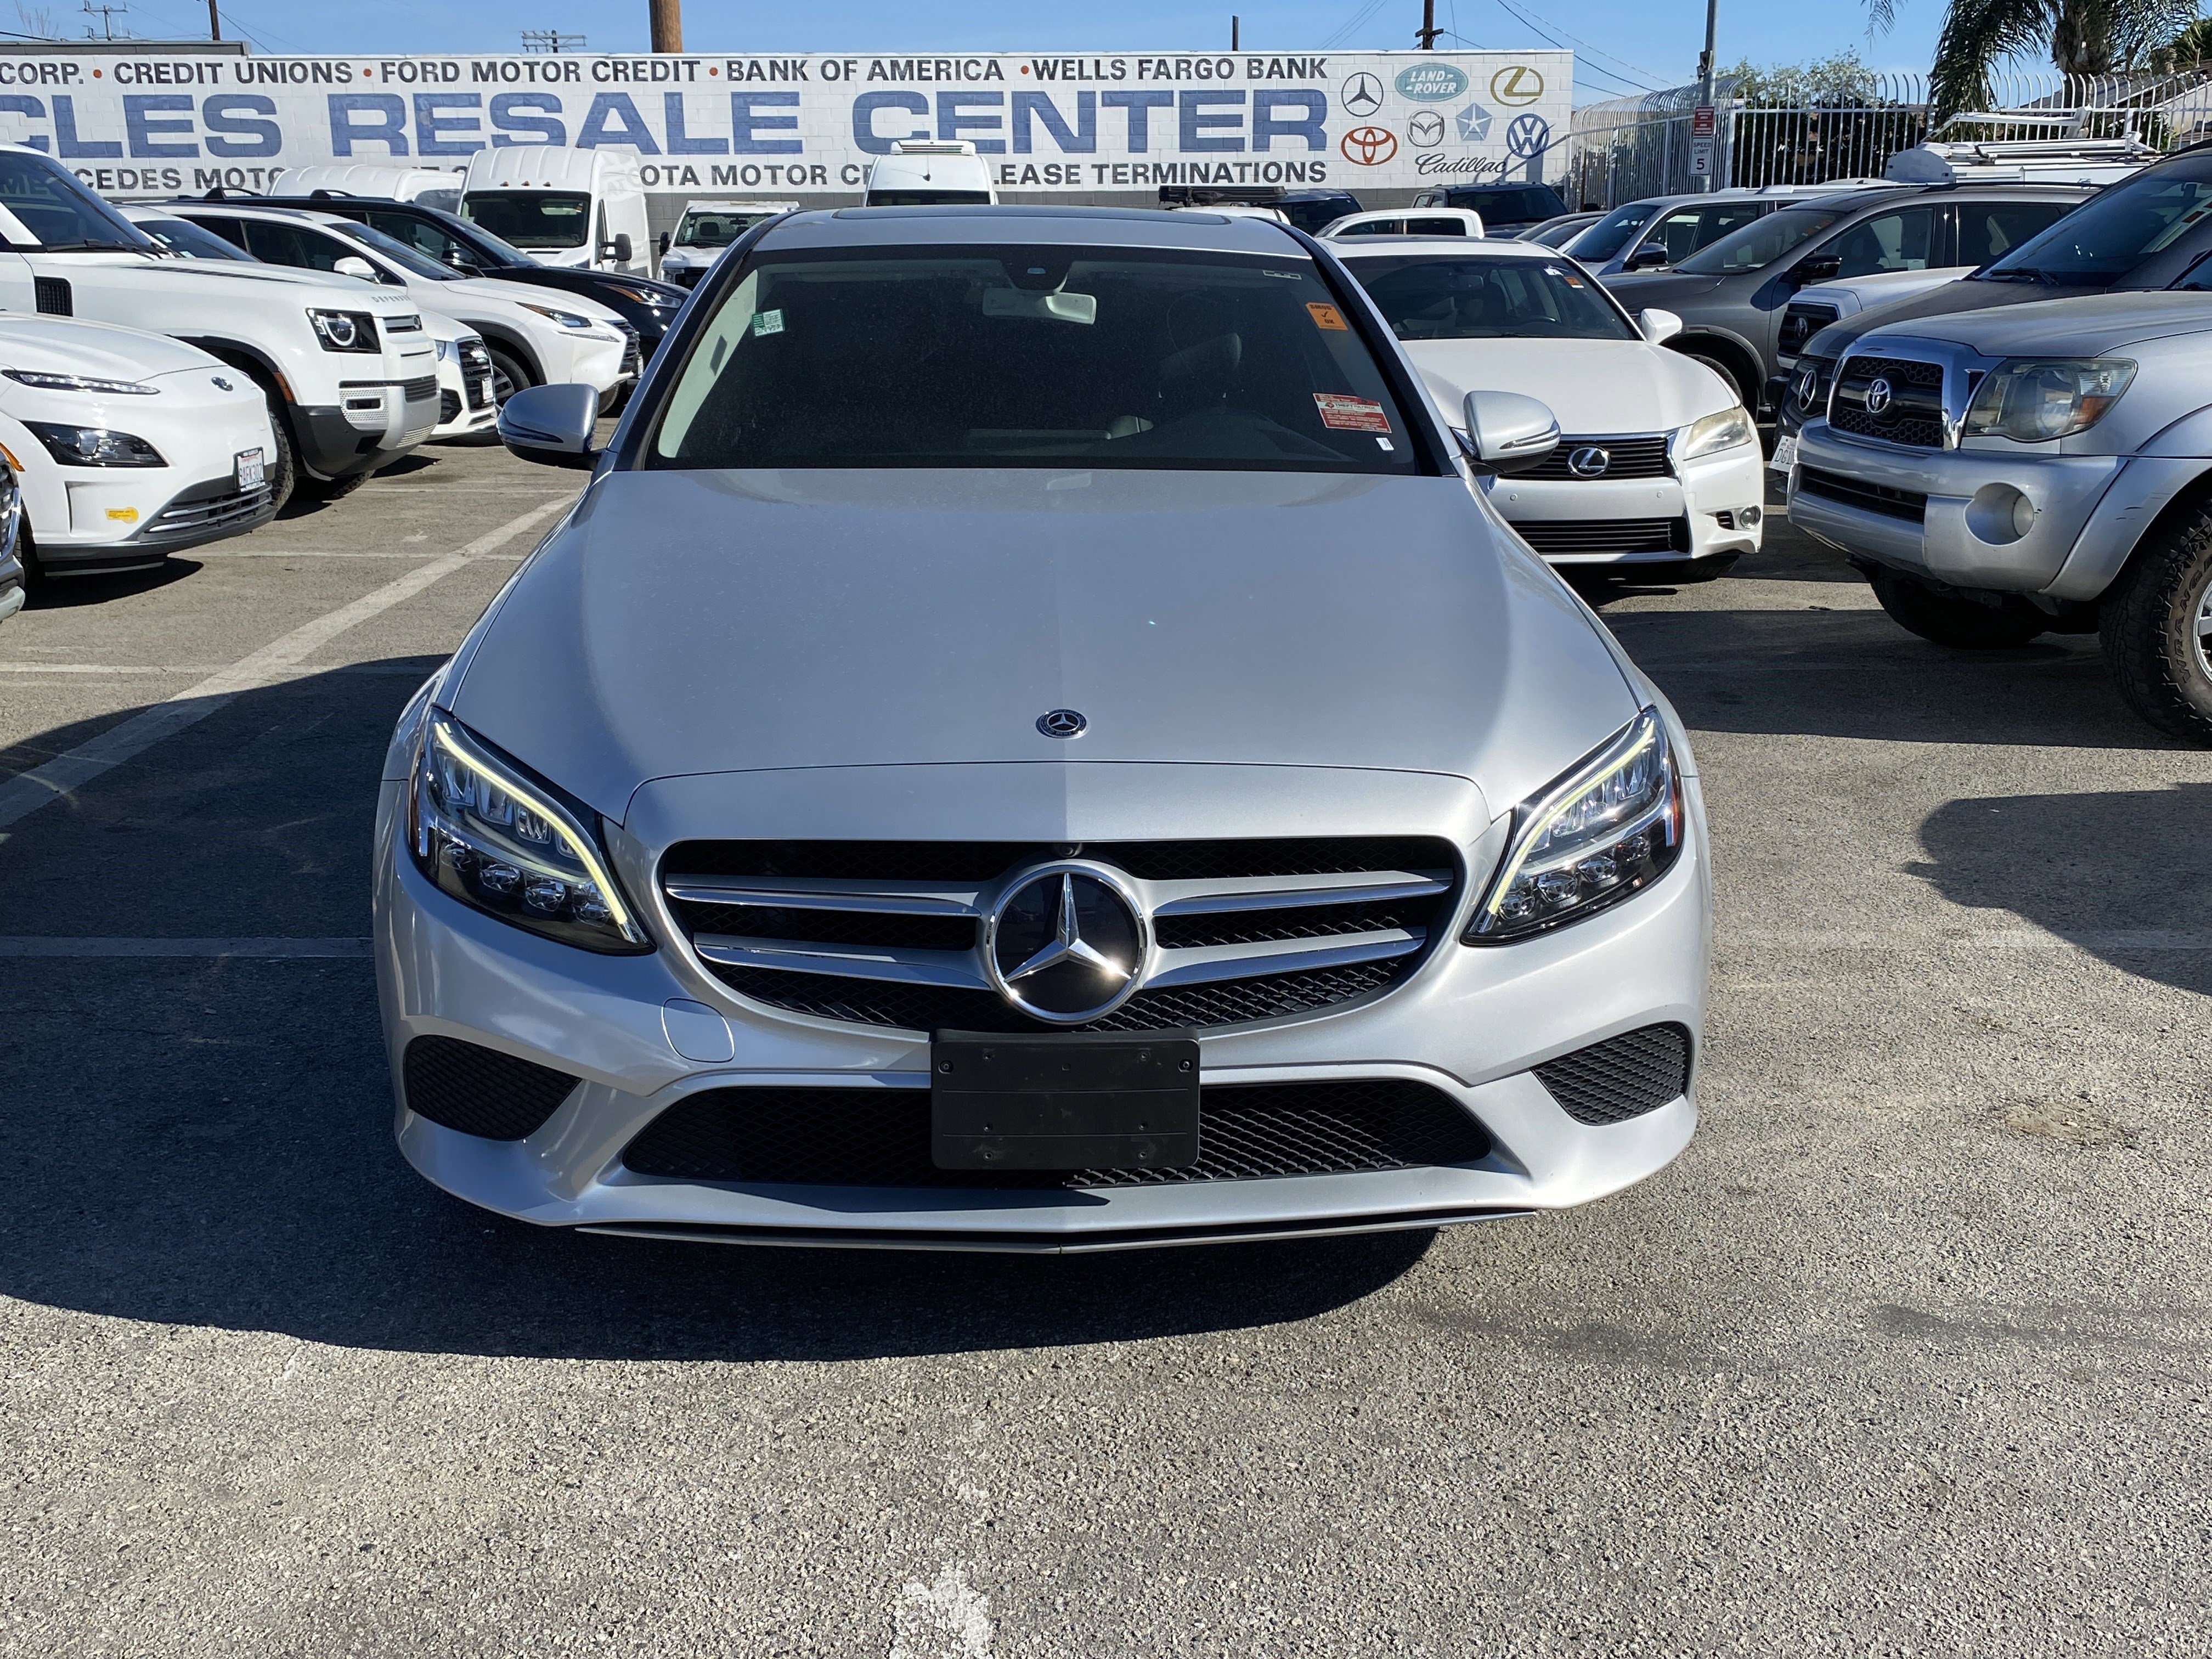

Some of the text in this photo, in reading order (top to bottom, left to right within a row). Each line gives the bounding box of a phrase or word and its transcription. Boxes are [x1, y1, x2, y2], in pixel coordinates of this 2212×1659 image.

[114, 63, 223, 84] CREDIT
[234, 62, 353, 84] UNIONS
[381, 61, 460, 83] FORD
[472, 61, 581, 83] MOTOR
[592, 60, 701, 82] CREDIT
[727, 60, 809, 81] BANK
[821, 60, 858, 81] OF
[867, 59, 1005, 81] AMERICA
[1032, 59, 1127, 81] WELLS
[1138, 58, 1234, 80] FARGO
[1247, 58, 1328, 80] BANK
[328, 92, 804, 157] RESALE
[853, 89, 1327, 155] CENTER
[711, 164, 827, 186] MOTOR
[994, 161, 1327, 185] EASE TERMINATIONS
[1415, 153, 1506, 175] Cadillac
[1696, 157, 1705, 170] 5
